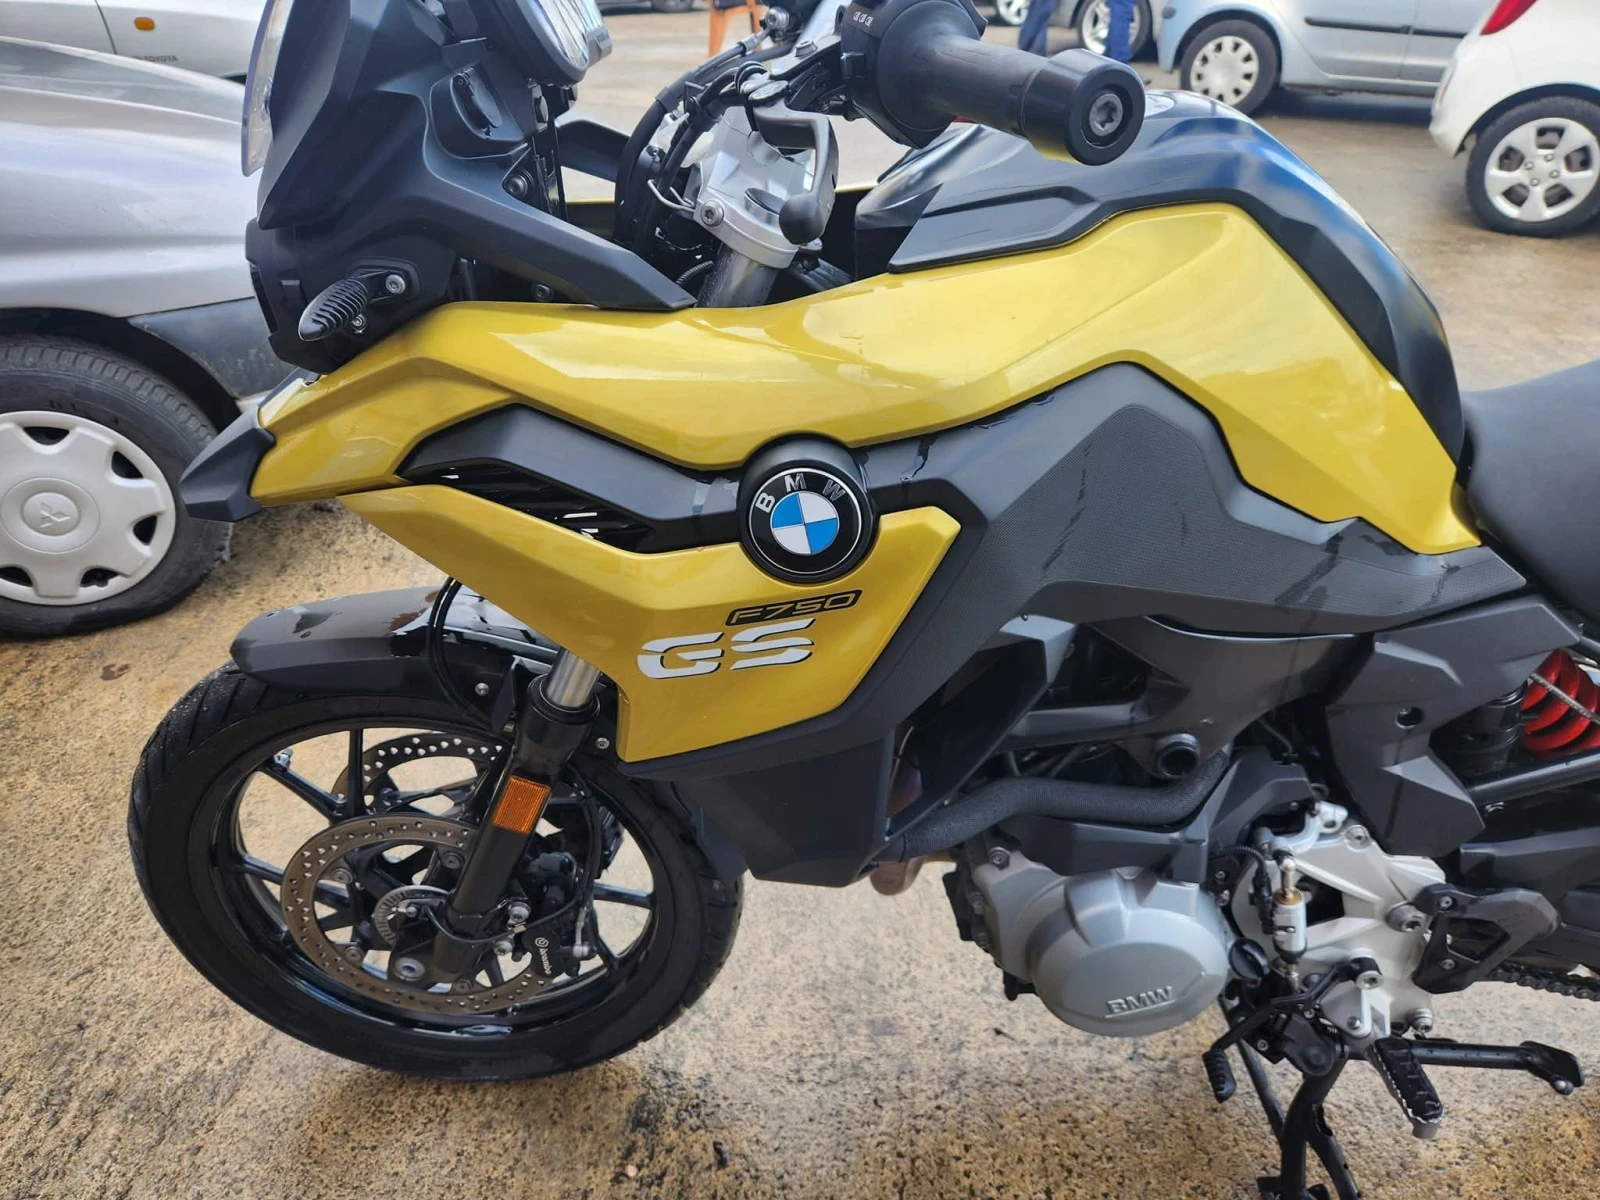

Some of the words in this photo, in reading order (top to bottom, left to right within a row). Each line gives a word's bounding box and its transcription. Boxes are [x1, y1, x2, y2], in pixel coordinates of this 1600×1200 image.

[755, 472, 846, 514] BMW
[729, 592, 860, 624] F750
[637, 617, 816, 680] GS
[1106, 985, 1173, 1014] BMW
